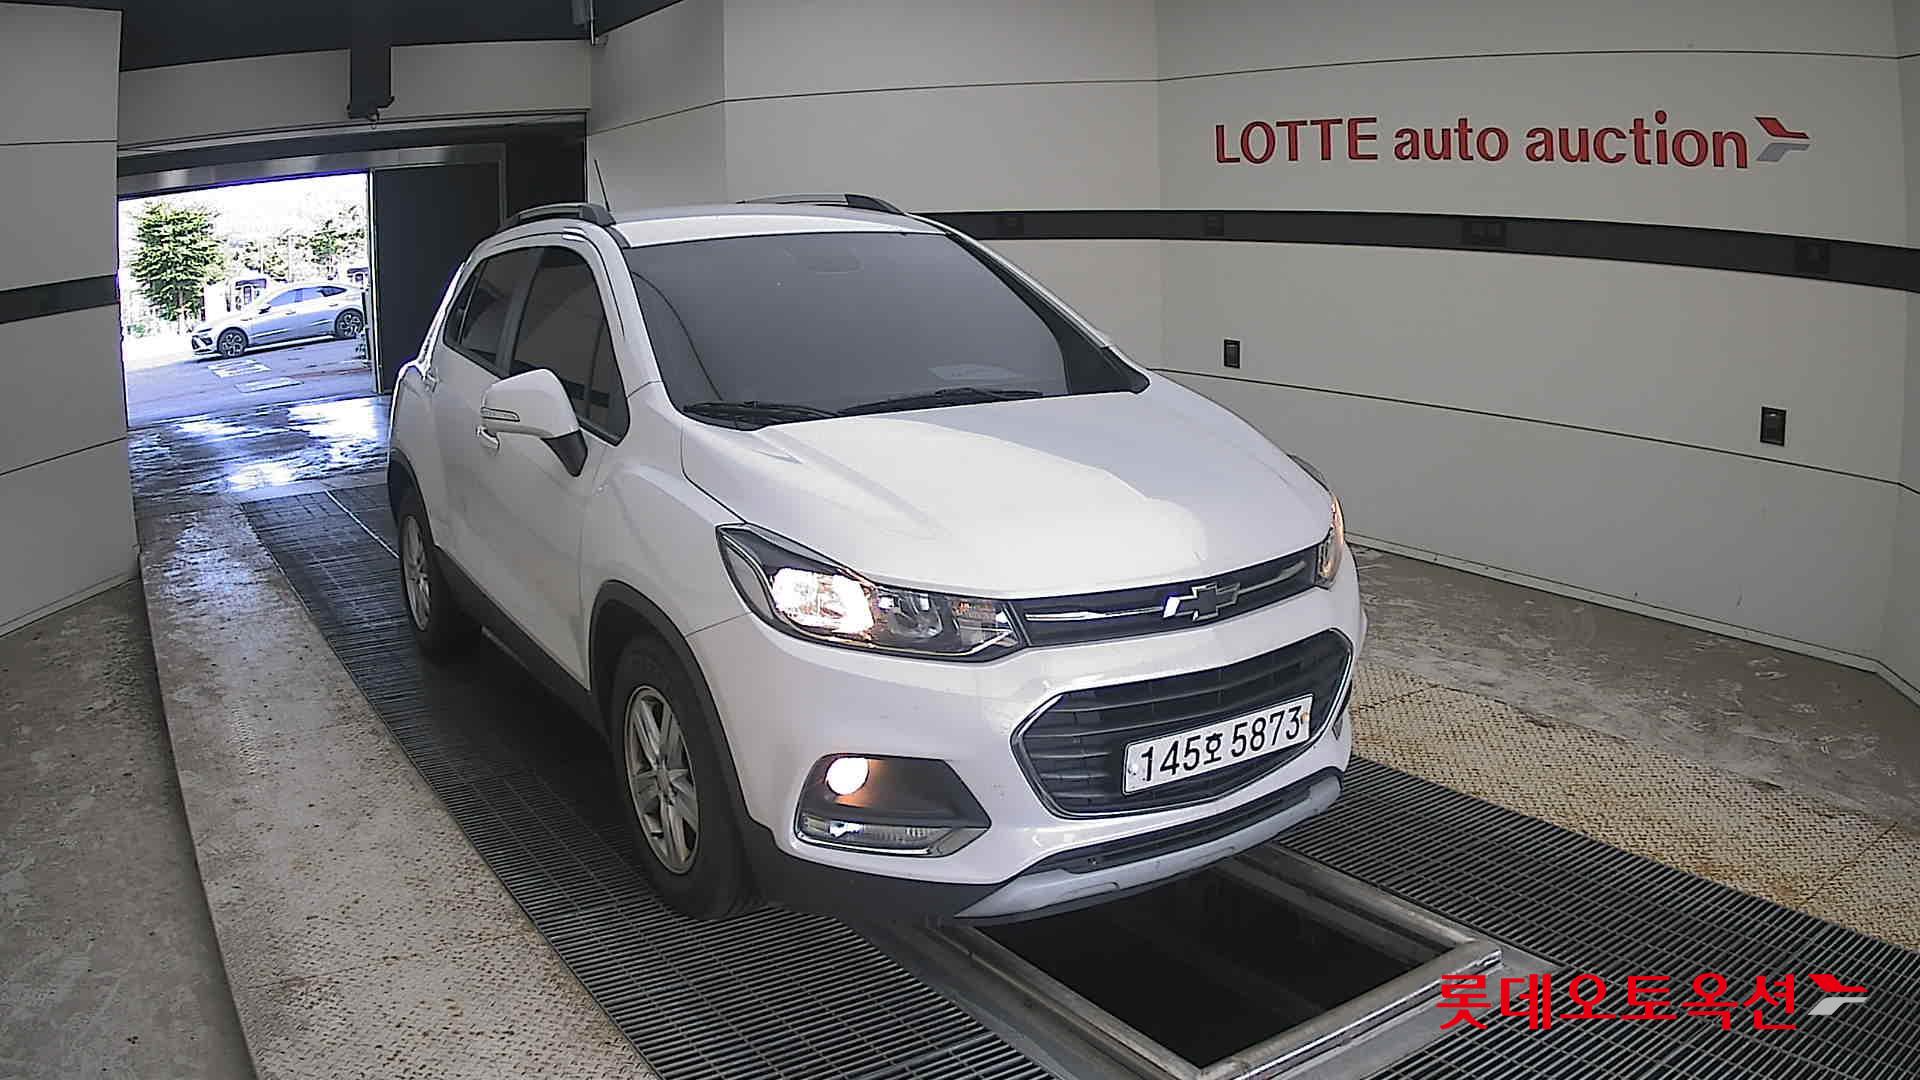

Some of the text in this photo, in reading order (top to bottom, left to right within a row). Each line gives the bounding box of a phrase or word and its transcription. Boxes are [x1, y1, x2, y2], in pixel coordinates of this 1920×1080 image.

[1215, 110, 1749, 169] LOTTE auto auction
[1141, 706, 1302, 781] 145호 5873
